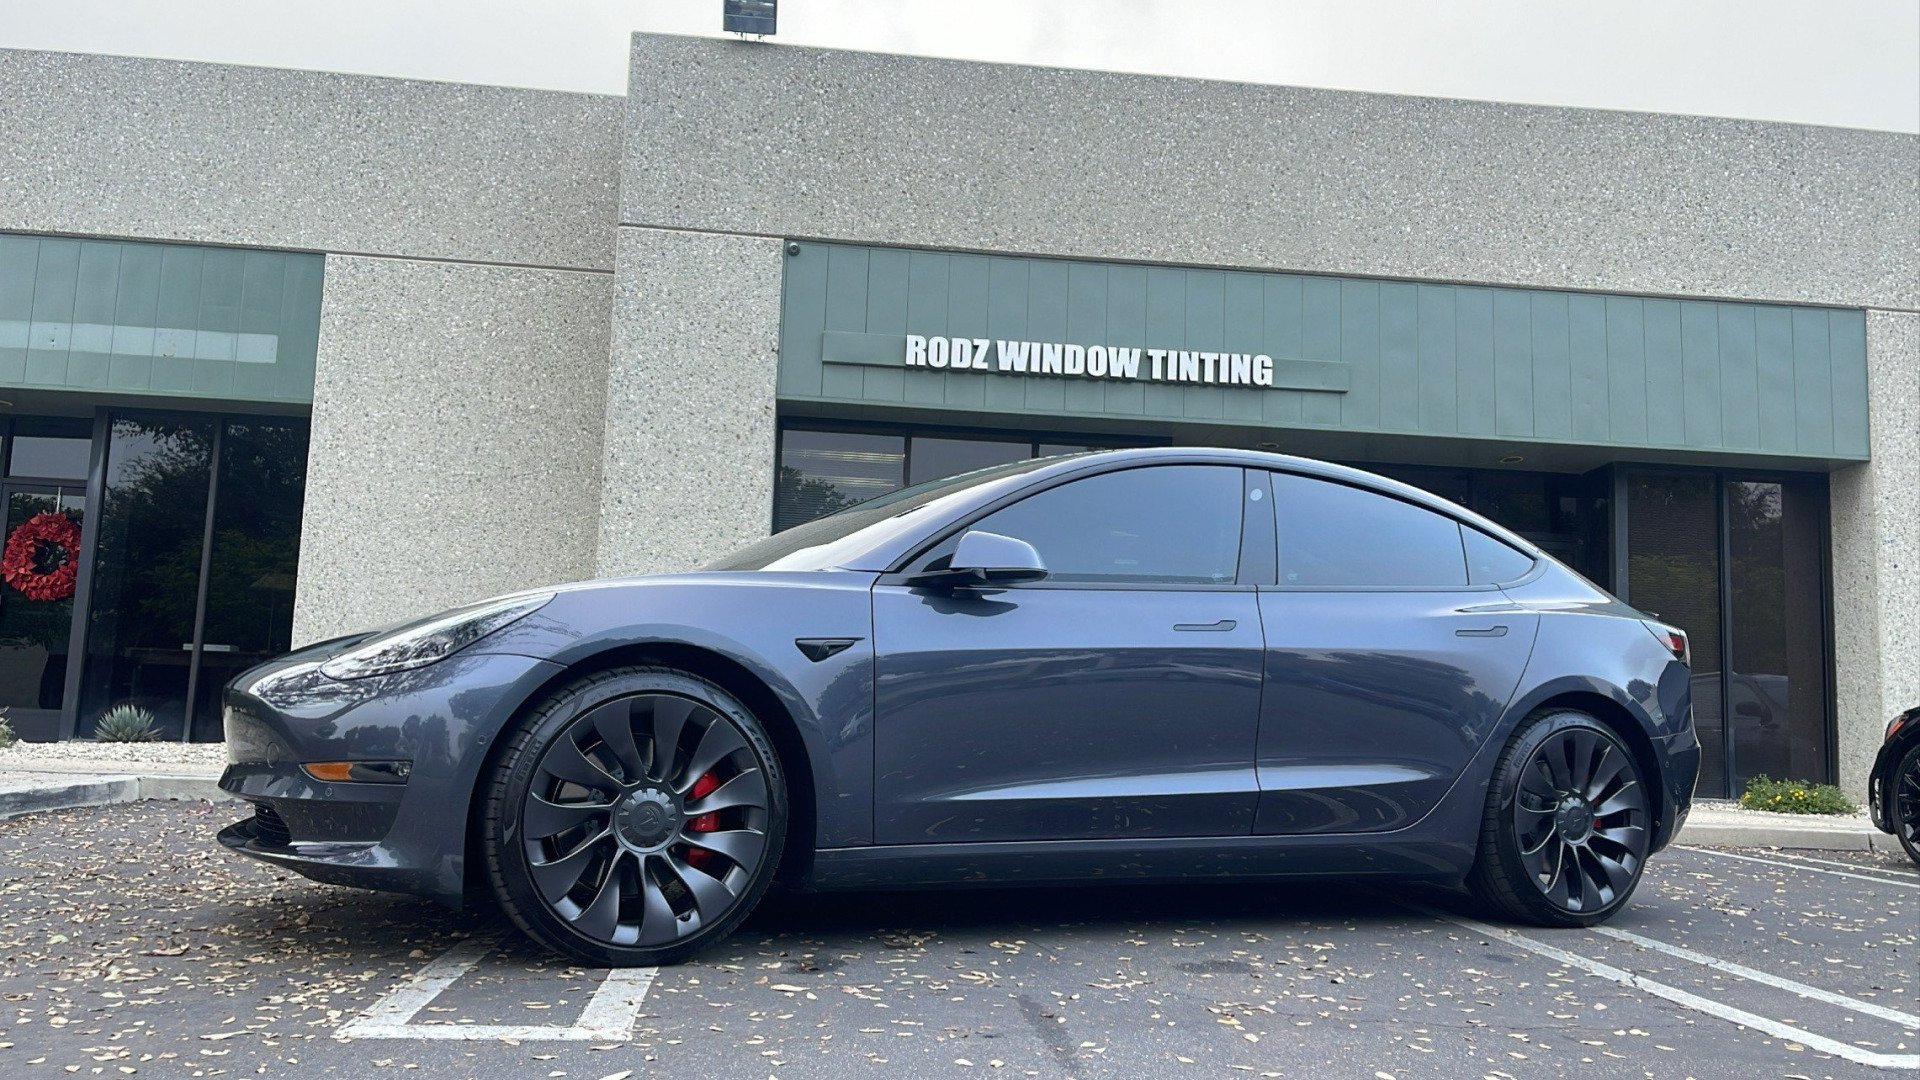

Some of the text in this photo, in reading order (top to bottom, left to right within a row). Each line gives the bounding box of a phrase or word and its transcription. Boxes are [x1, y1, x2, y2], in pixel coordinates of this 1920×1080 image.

[905, 334, 1273, 386] RODZ WINDOW TINTING
[745, 725, 777, 779] ZERO
